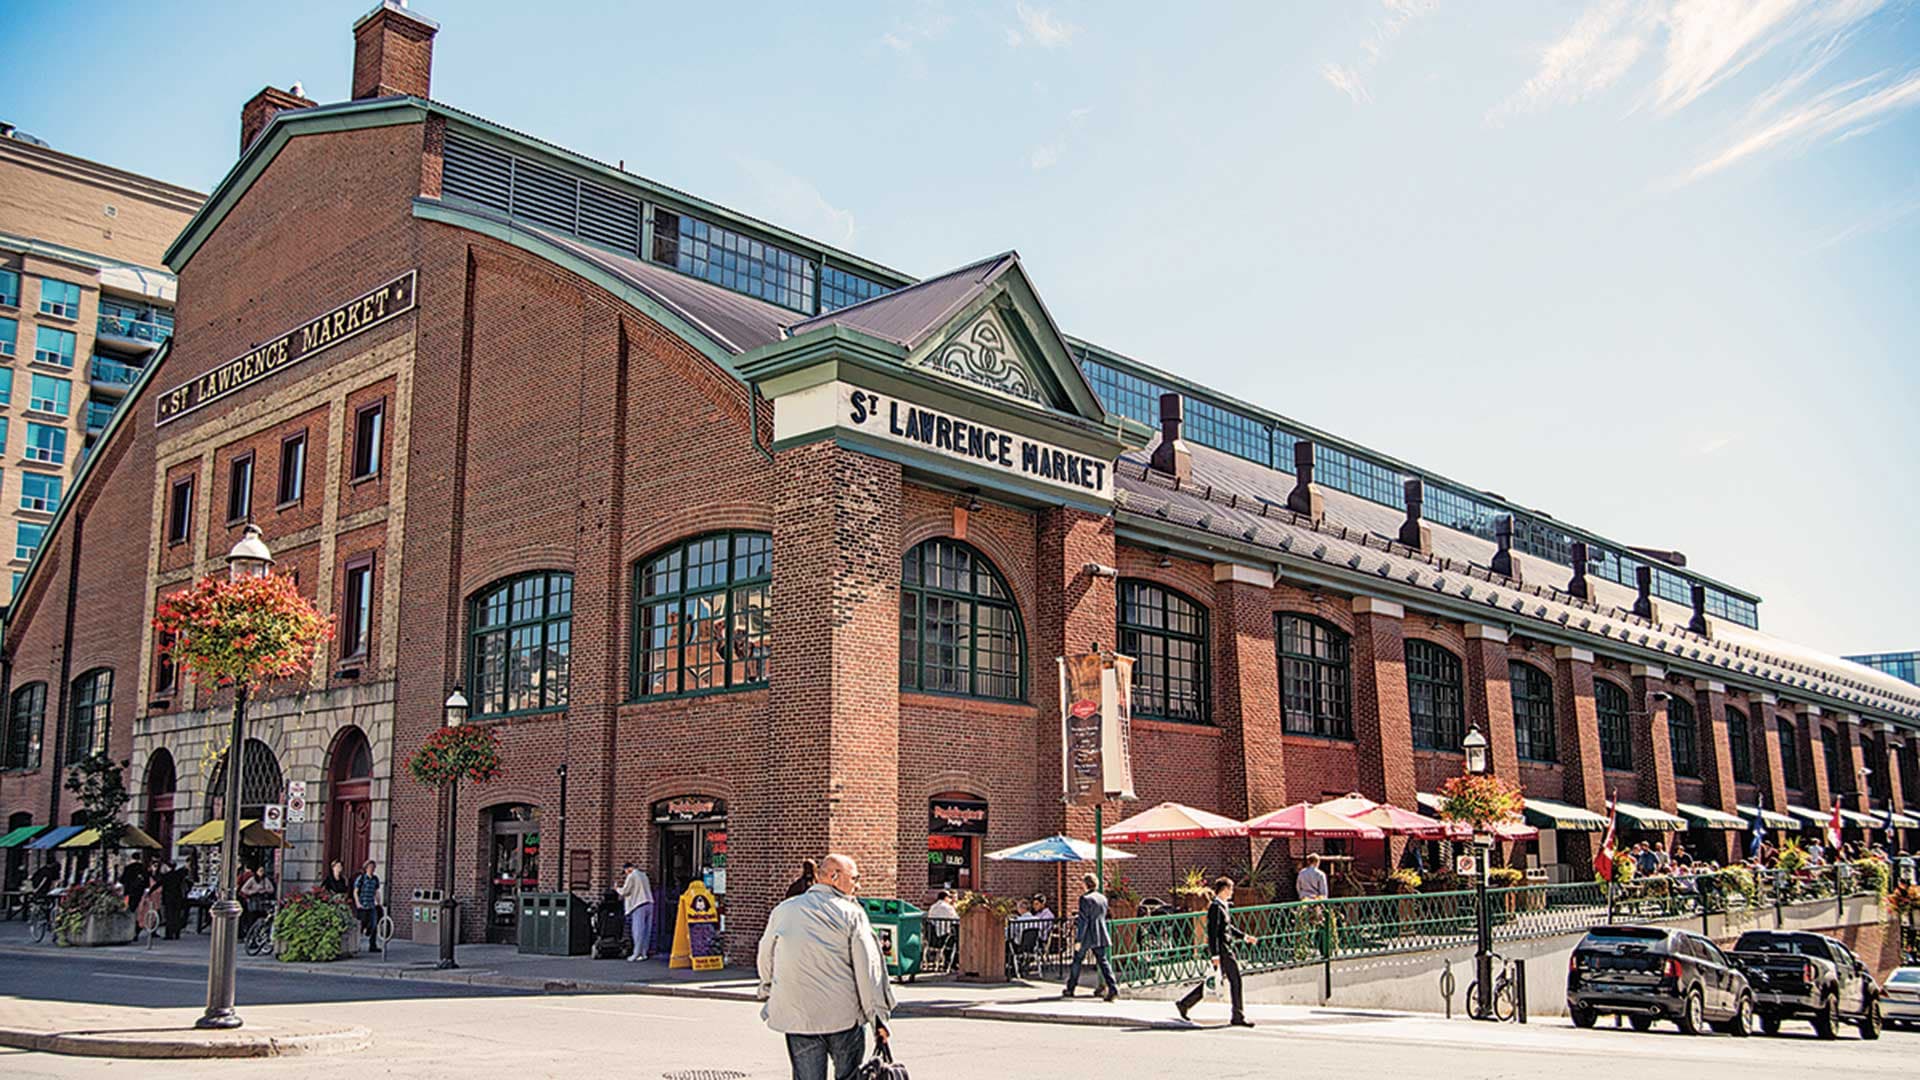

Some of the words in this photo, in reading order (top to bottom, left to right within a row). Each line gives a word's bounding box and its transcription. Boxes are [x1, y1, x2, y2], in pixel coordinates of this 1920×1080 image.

[171, 386, 190, 414] ST
[197, 337, 289, 402] LAWRENCE
[301, 287, 390, 353] MARKET
[889, 401, 1013, 468] LAWRENCE
[1021, 441, 1106, 492] MARKET
